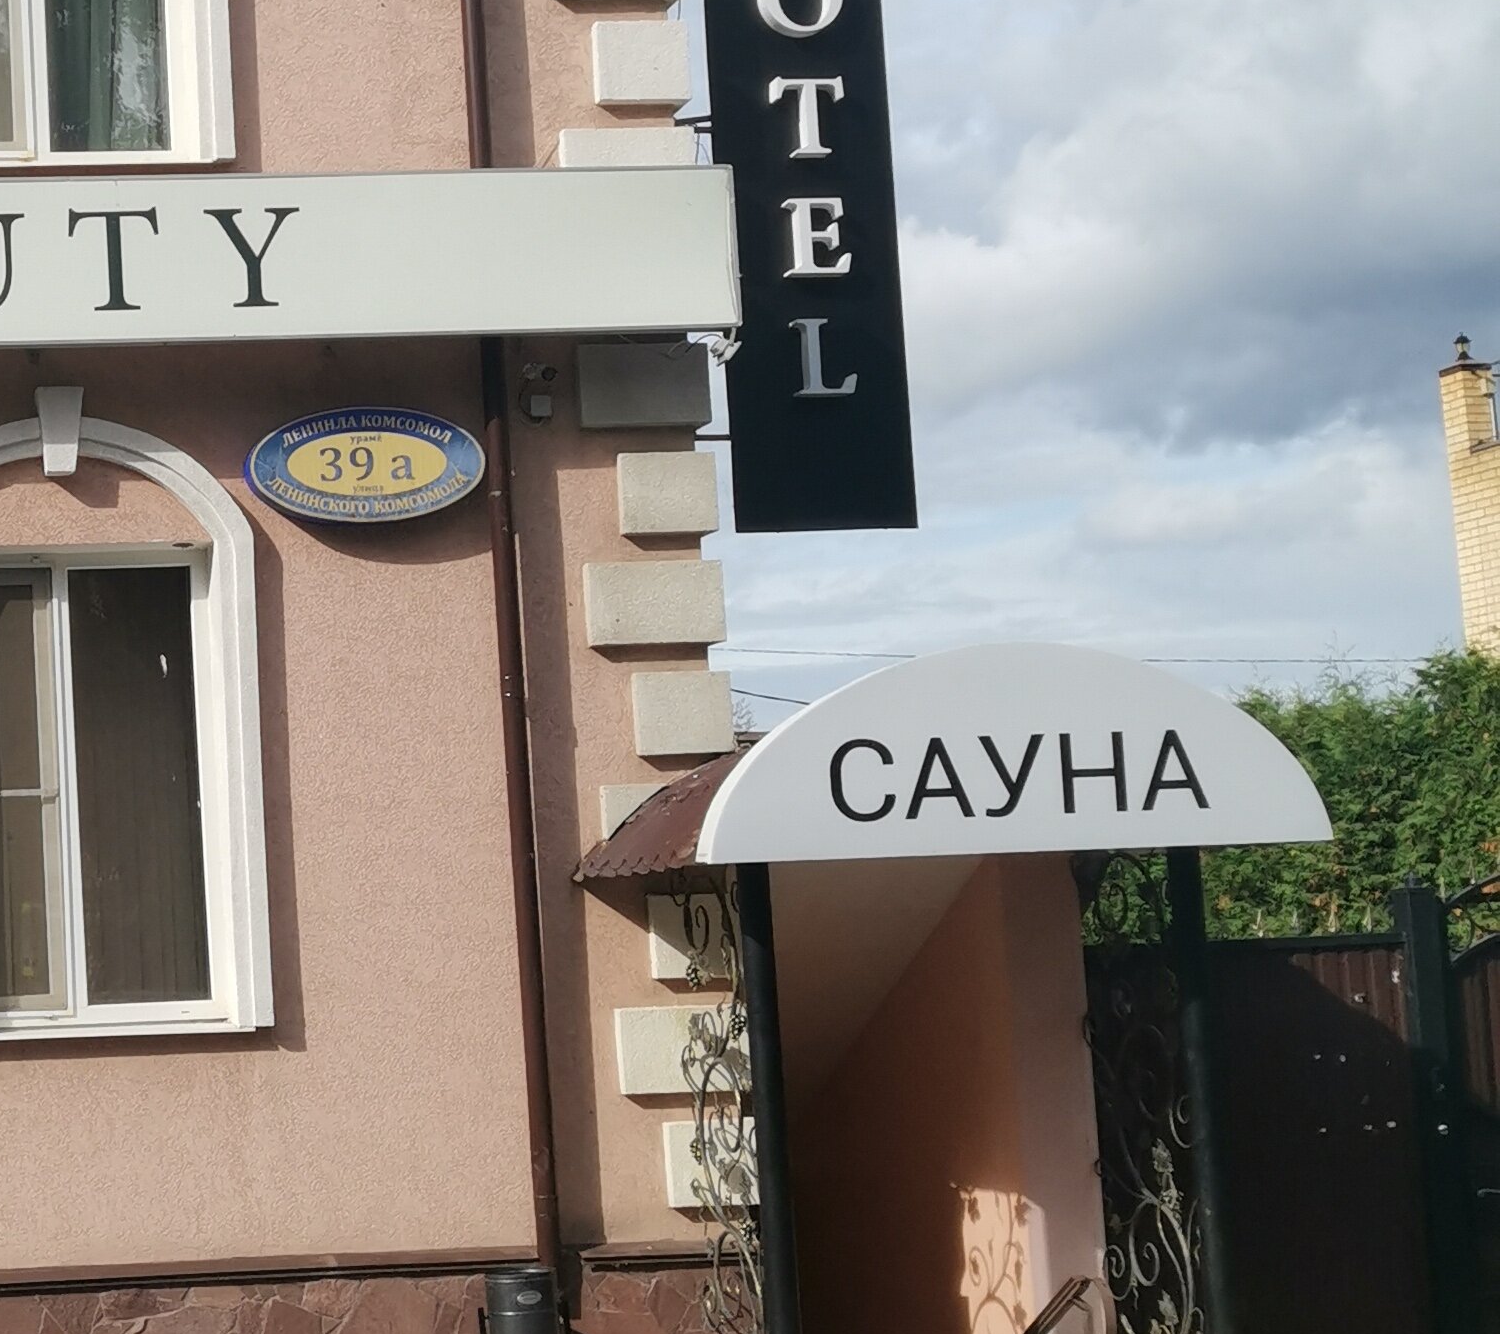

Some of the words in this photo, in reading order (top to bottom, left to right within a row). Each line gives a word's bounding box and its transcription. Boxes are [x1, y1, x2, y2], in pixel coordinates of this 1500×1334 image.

[360, 414, 453, 445] КОМСОМОЛ
[319, 446, 375, 483] 39
[269, 478, 370, 514] ЛЕНИНСКОГО
[374, 473, 470, 514] КОМСОМОЛА
[829, 729, 1211, 822] САУНА
